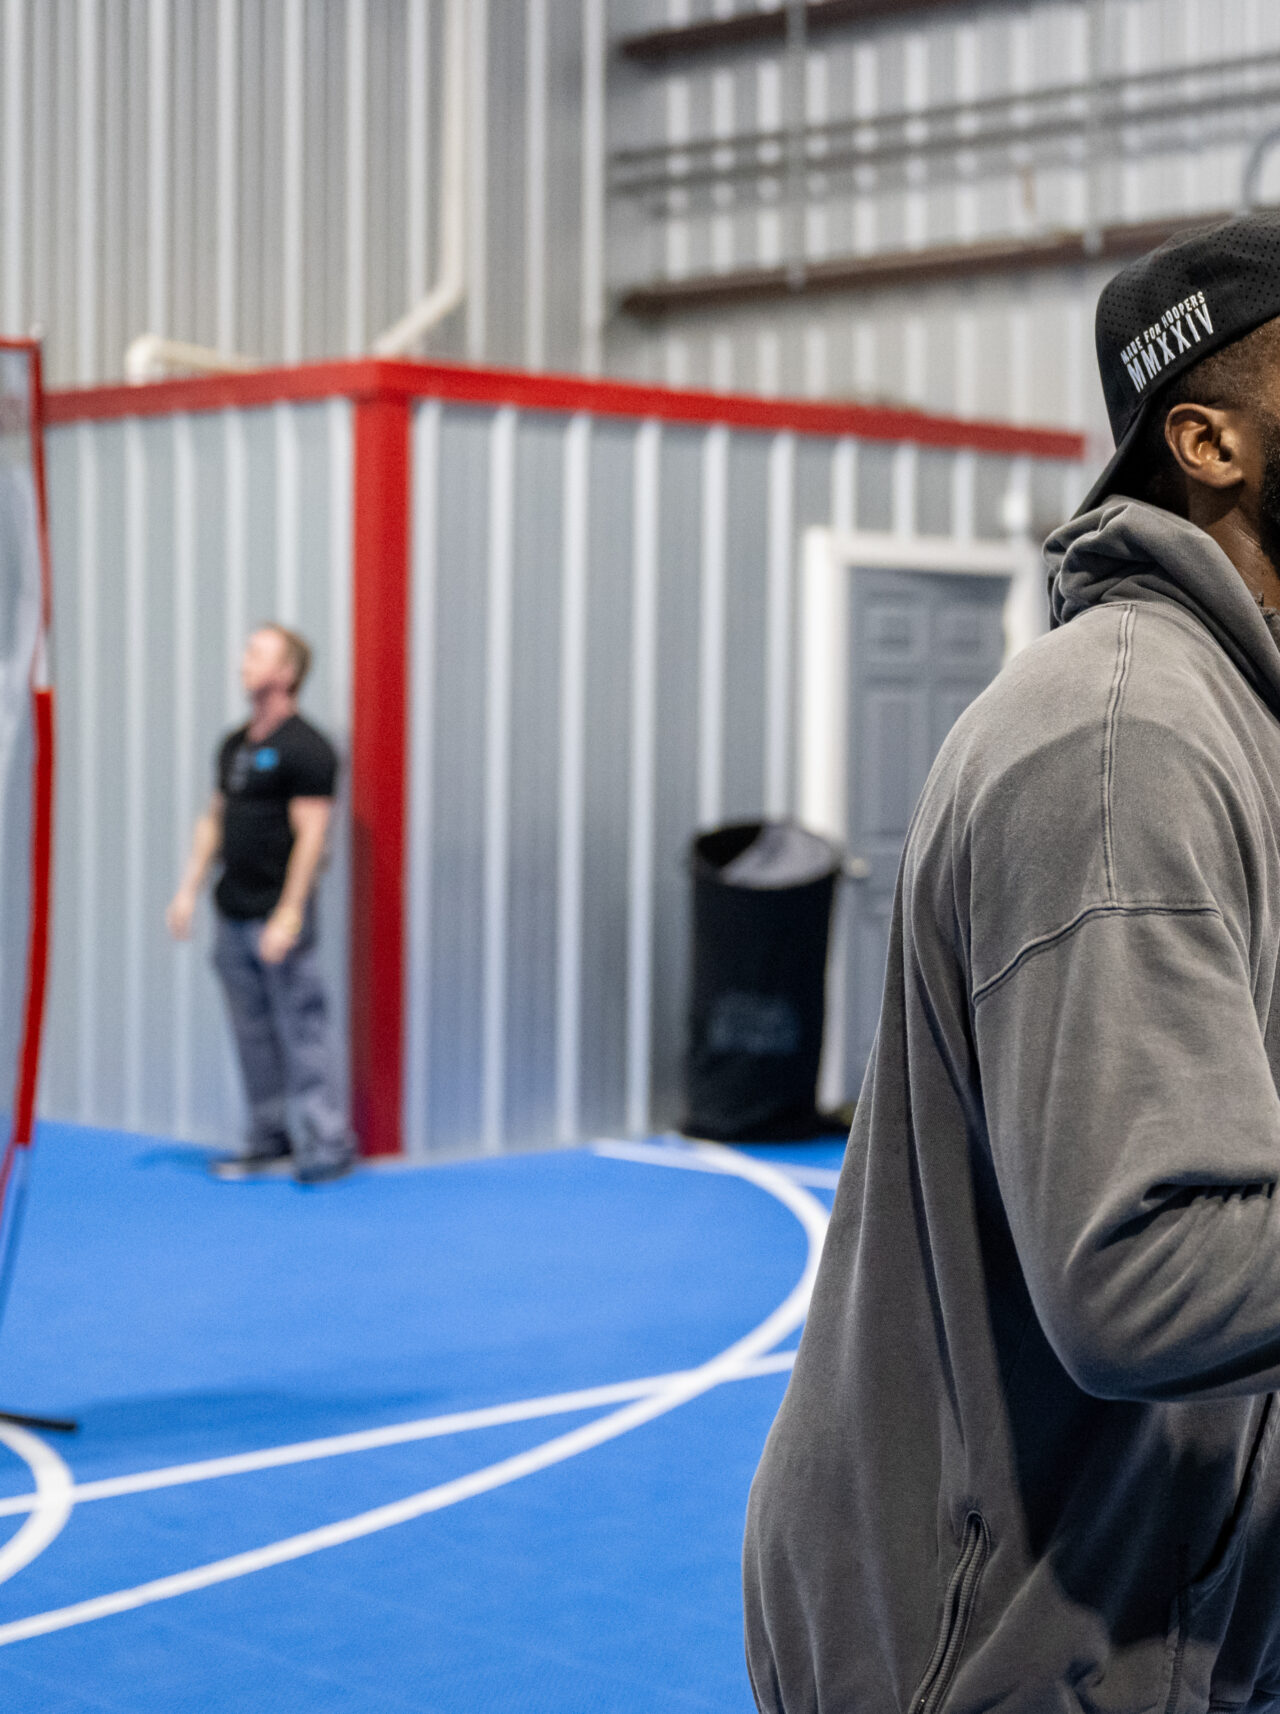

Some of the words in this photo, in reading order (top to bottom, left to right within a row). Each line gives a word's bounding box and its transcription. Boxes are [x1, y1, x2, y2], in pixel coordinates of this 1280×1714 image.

[1120, 336, 1143, 365] MADE
[1143, 323, 1162, 343] FOR
[1161, 291, 1205, 329] HOOPERS
[1126, 303, 1214, 393] MMXXIV
